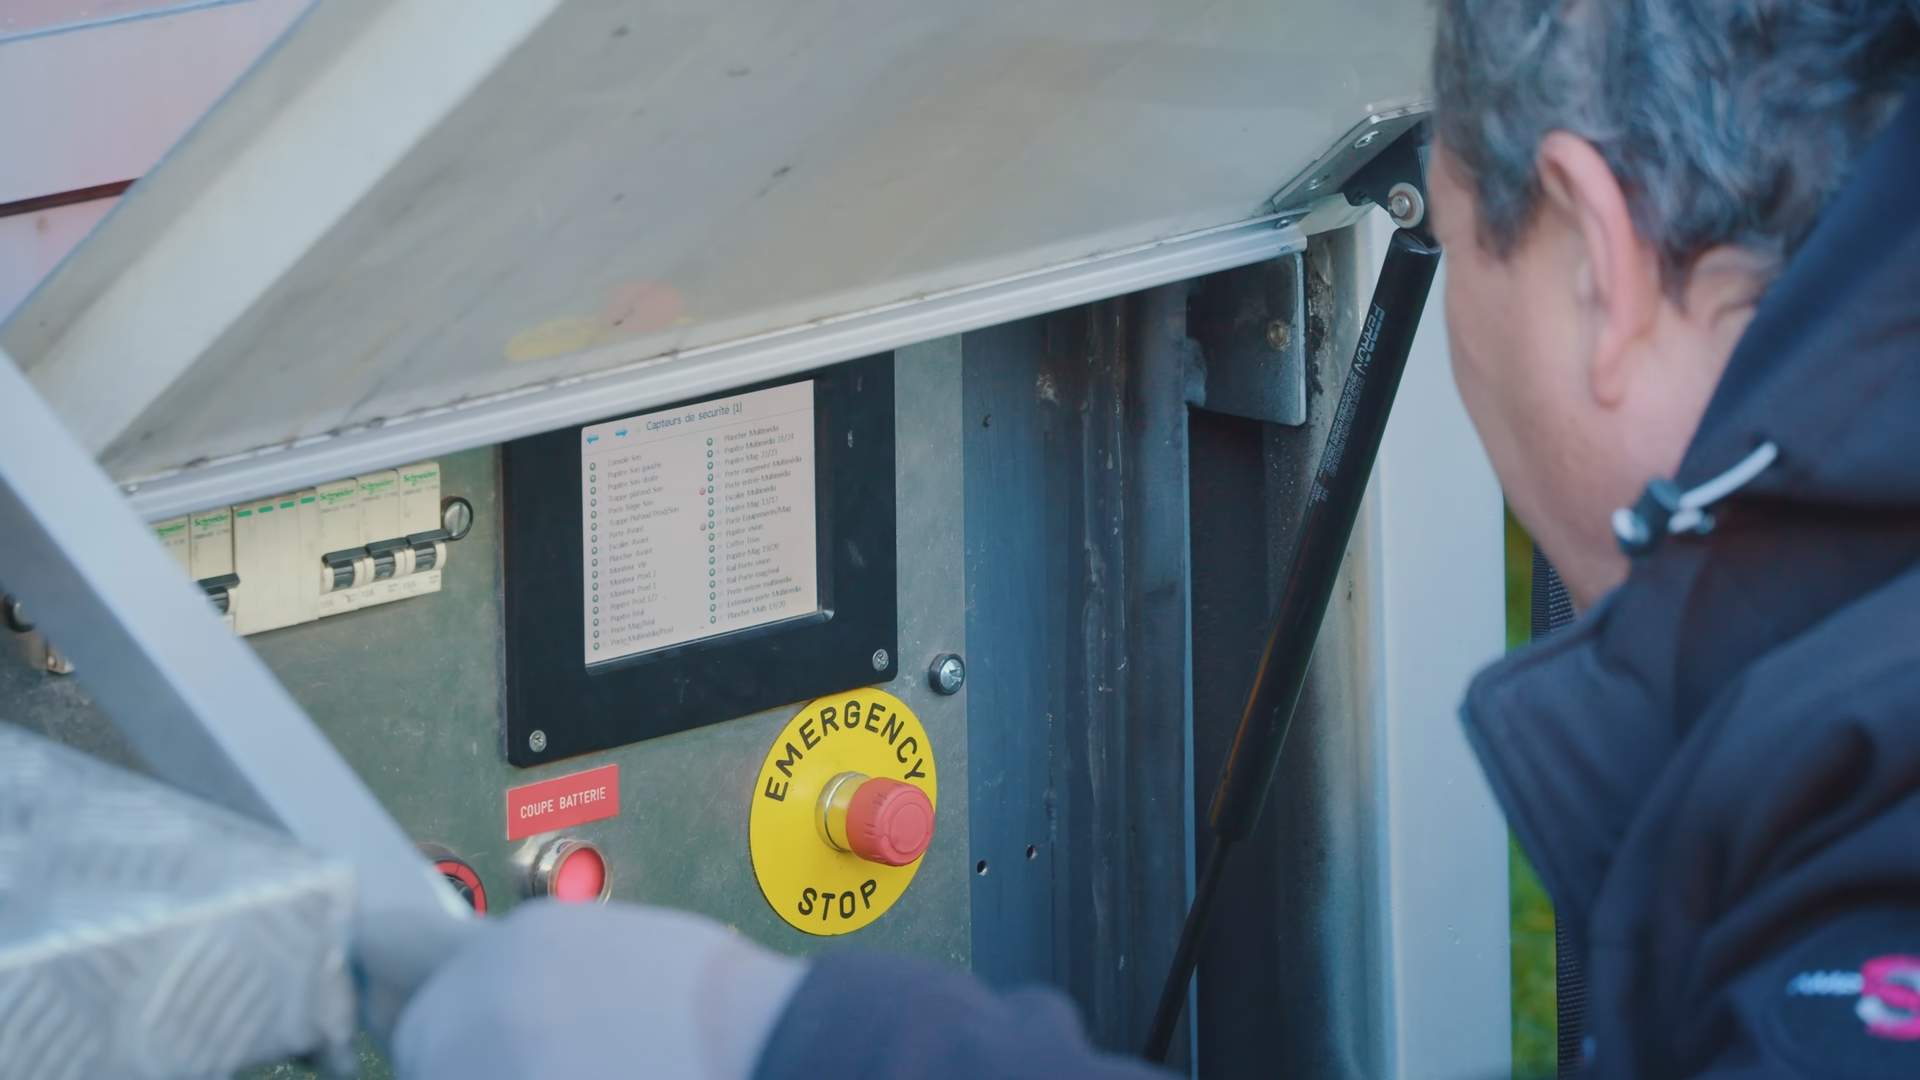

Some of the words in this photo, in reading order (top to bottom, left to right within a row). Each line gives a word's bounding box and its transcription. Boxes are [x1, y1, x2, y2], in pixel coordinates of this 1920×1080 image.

[646, 416, 682, 431] Capteurs
[685, 413, 695, 423] de
[732, 401, 743, 415] (1)
[764, 700, 927, 802] EMERGENCY
[520, 799, 554, 819] COUPE
[559, 786, 606, 810] BATTERIE
[798, 879, 877, 921] STOP
